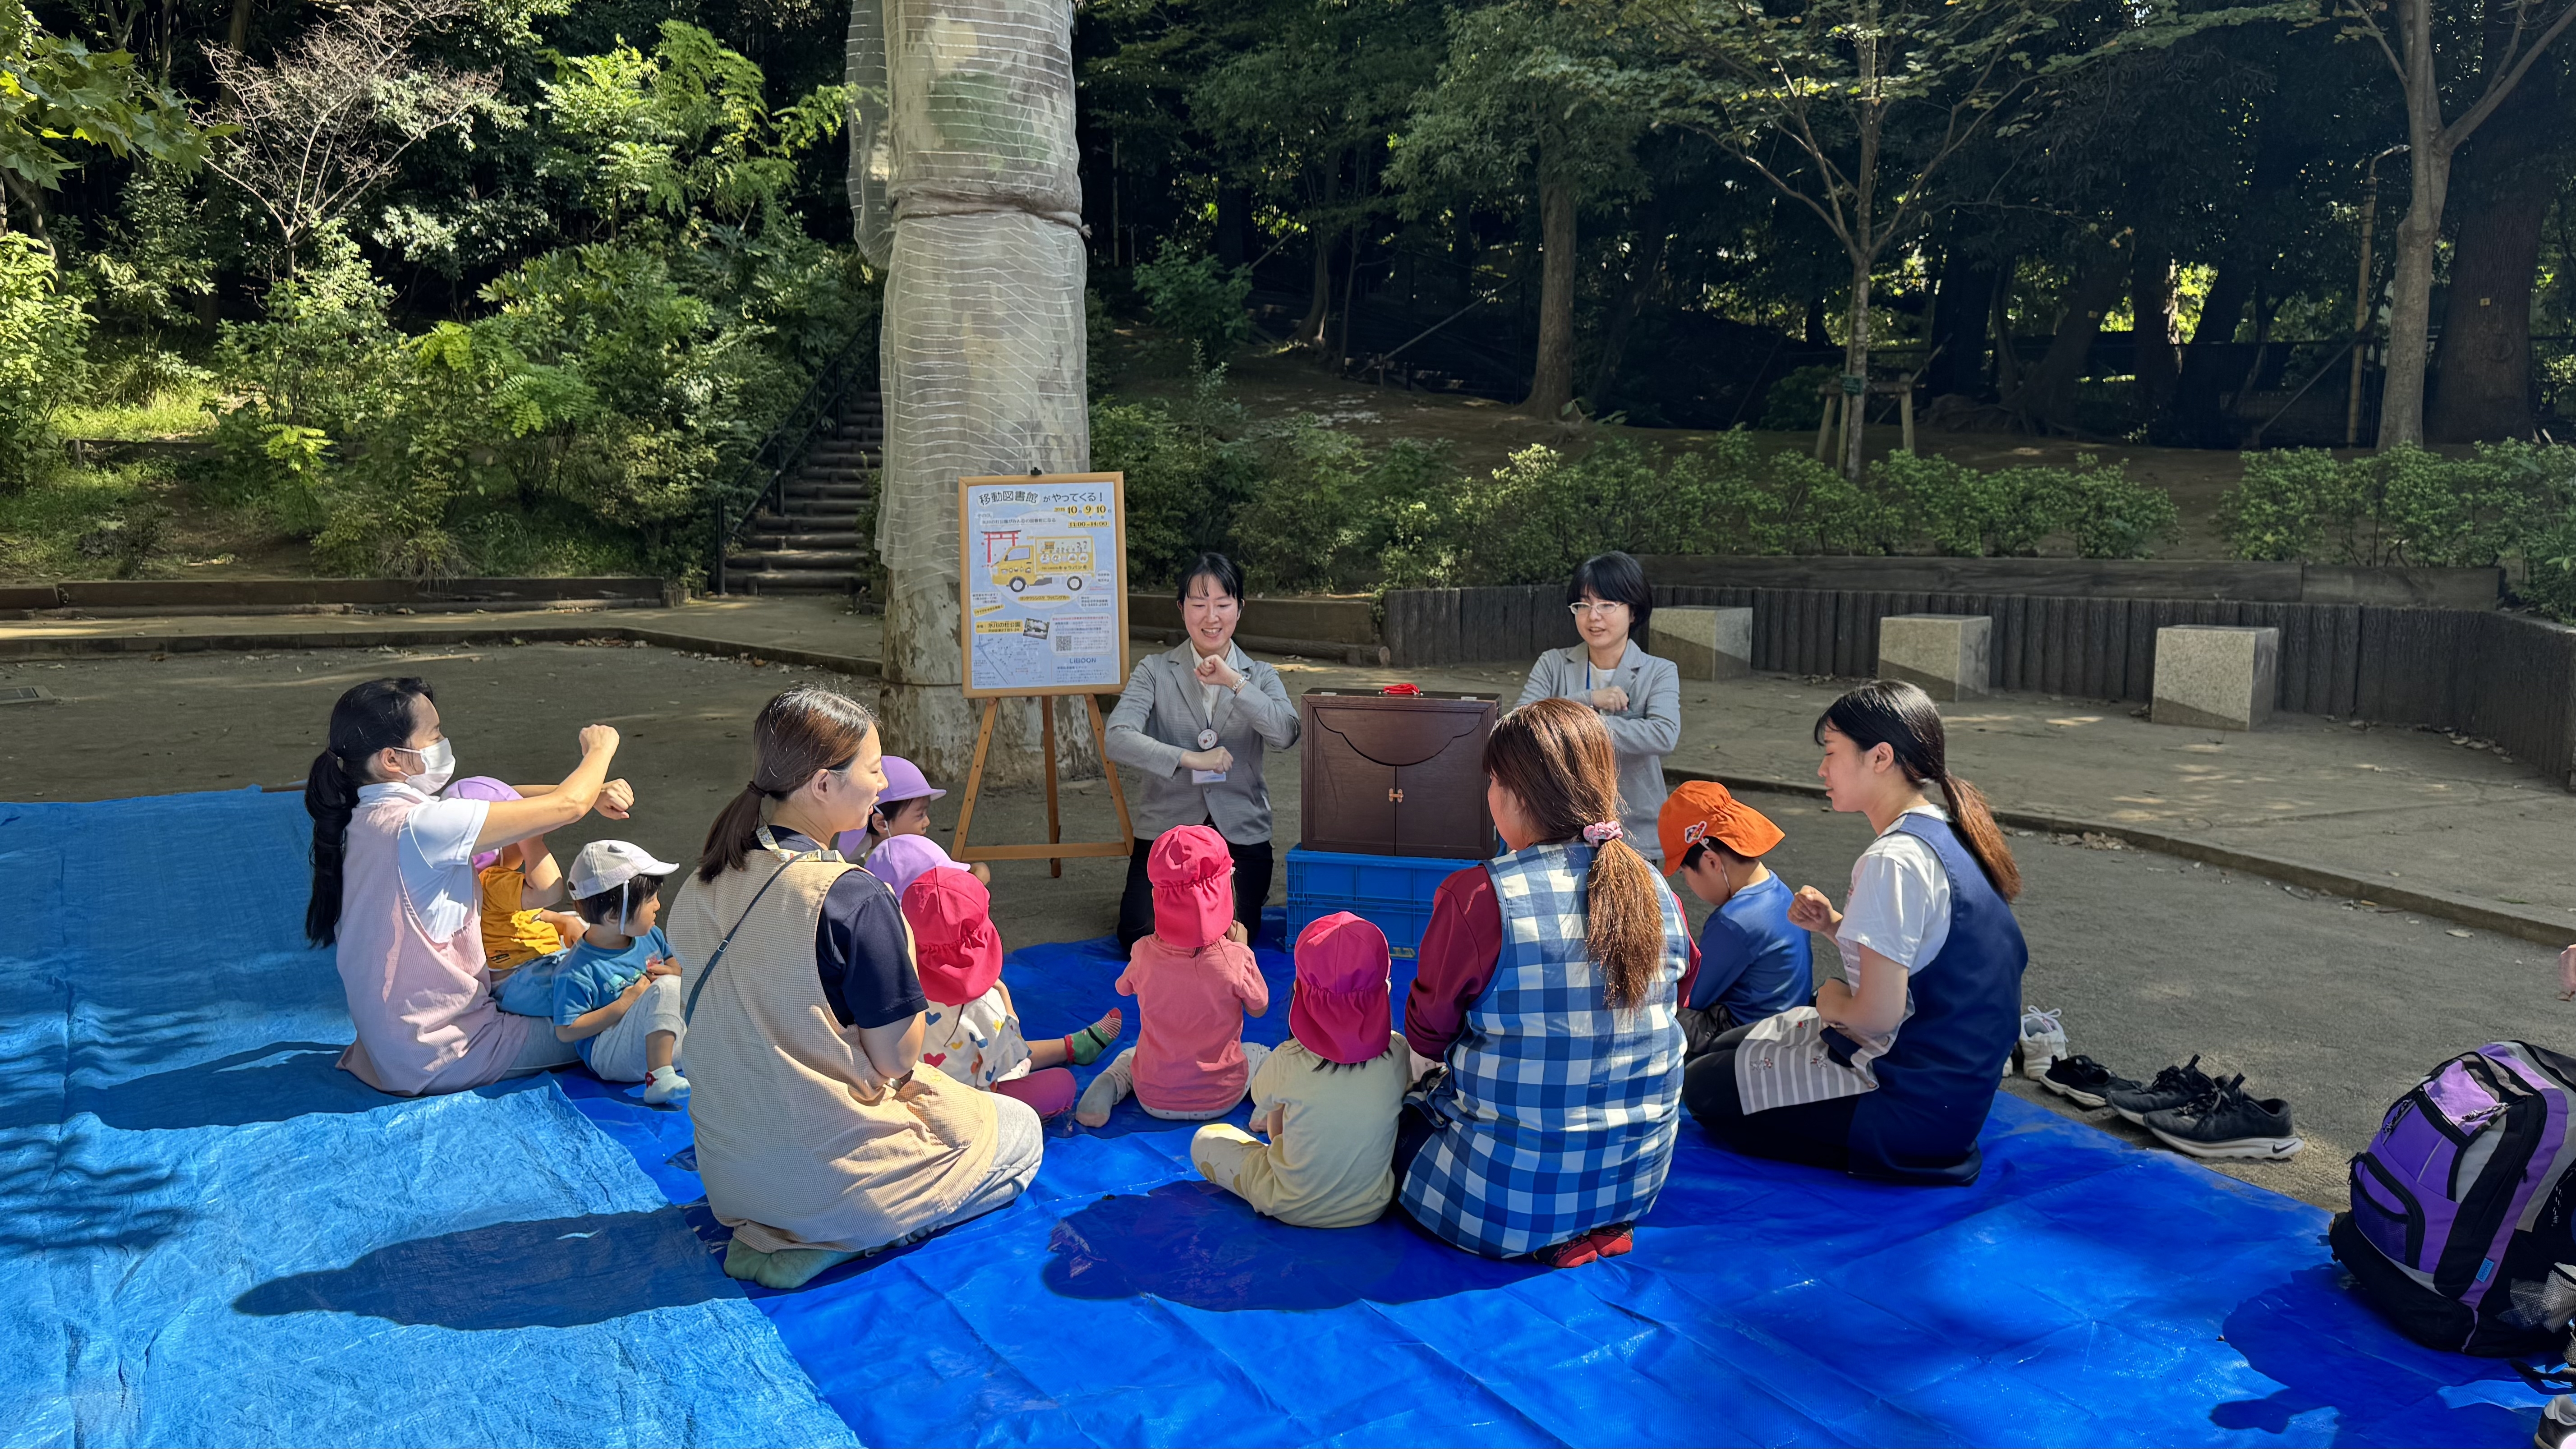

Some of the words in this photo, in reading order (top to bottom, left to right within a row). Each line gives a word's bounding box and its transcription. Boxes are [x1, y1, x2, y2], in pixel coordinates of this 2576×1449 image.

[979, 491, 1039, 506] 移動図書館
